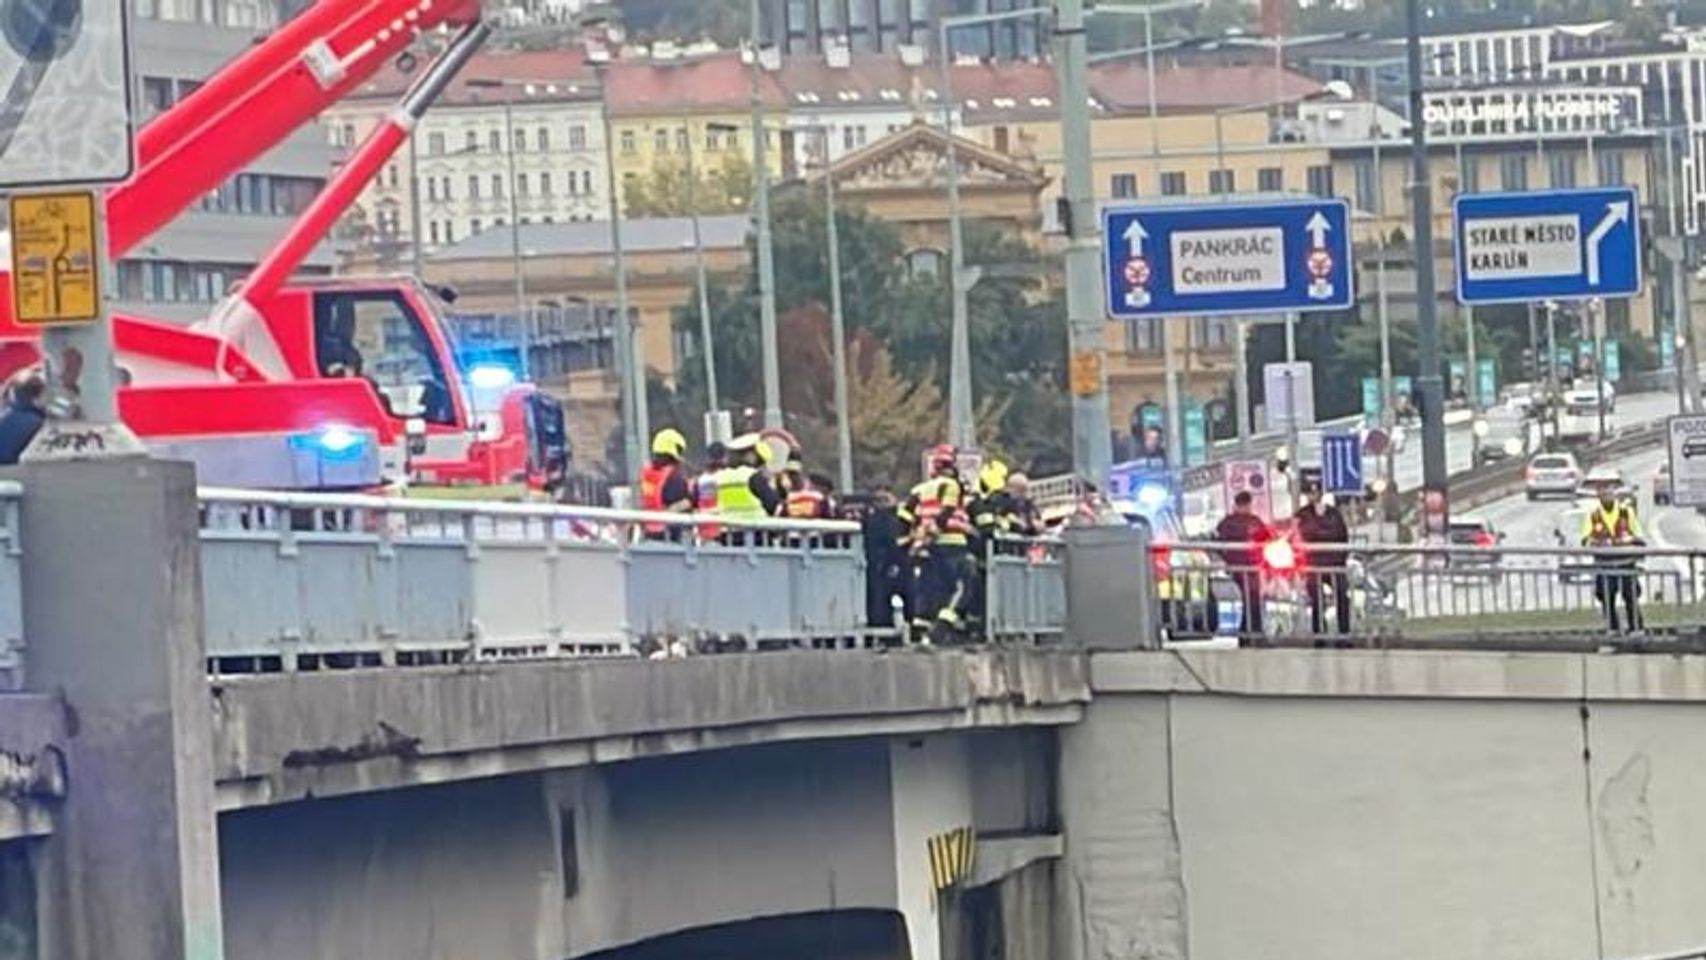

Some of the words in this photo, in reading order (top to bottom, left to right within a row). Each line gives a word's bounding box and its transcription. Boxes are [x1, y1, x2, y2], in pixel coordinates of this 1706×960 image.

[1470, 224, 1518, 246] STARÉ
[1525, 222, 1575, 243] MĚSTO
[1180, 235, 1273, 257] PANKRÁC
[1471, 250, 1529, 270] KARLÍN
[1181, 266, 1262, 284] Centrum
